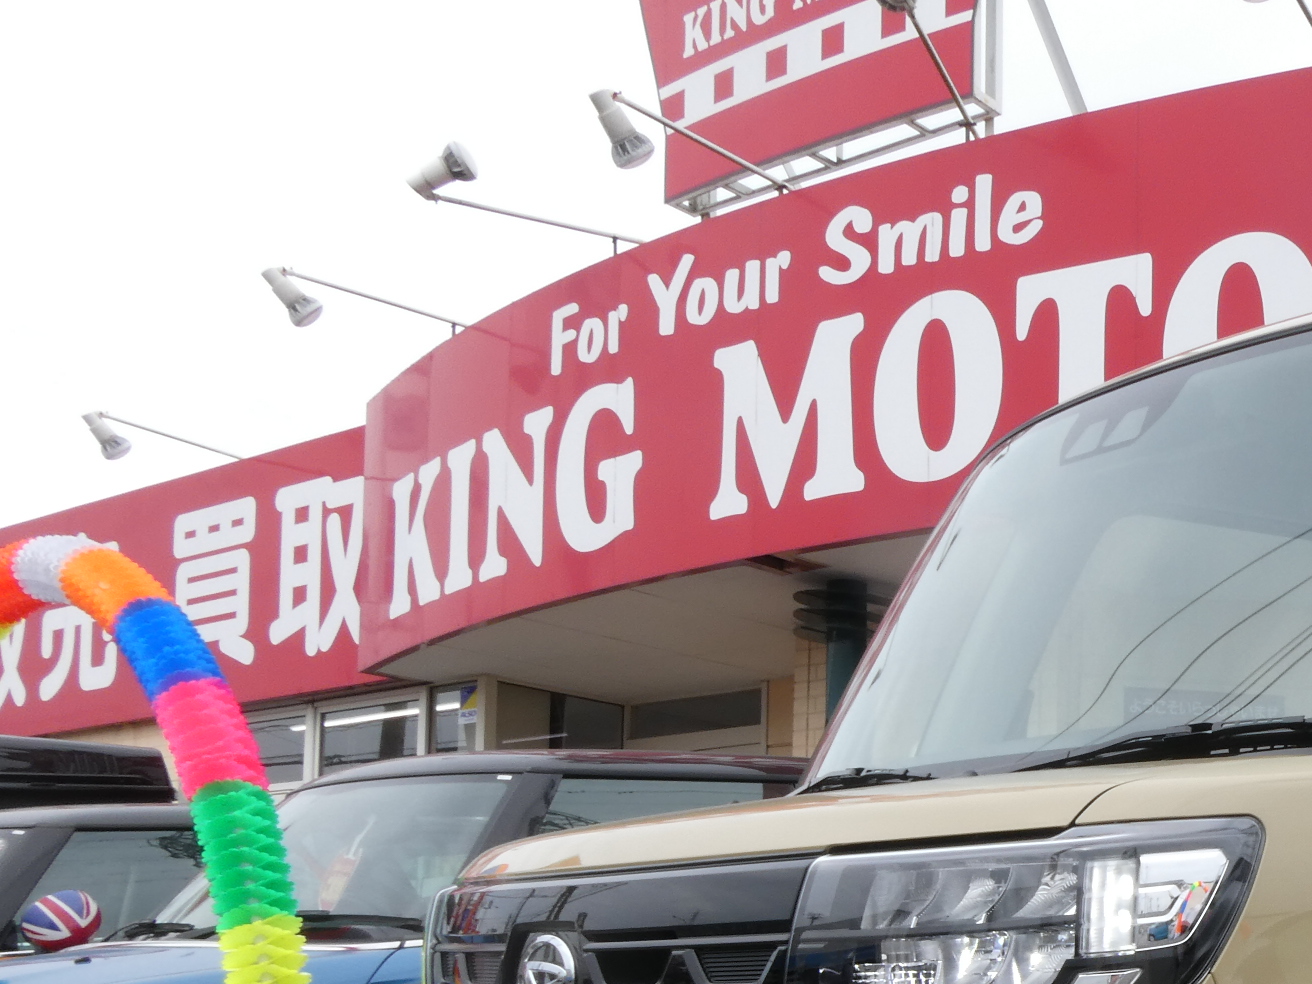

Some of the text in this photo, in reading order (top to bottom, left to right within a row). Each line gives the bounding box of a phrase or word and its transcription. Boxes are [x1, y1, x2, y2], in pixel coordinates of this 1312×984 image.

[682, 0, 775, 59] KING
[550, 174, 1043, 376] For Your Smile
[388, 376, 643, 620] KING
